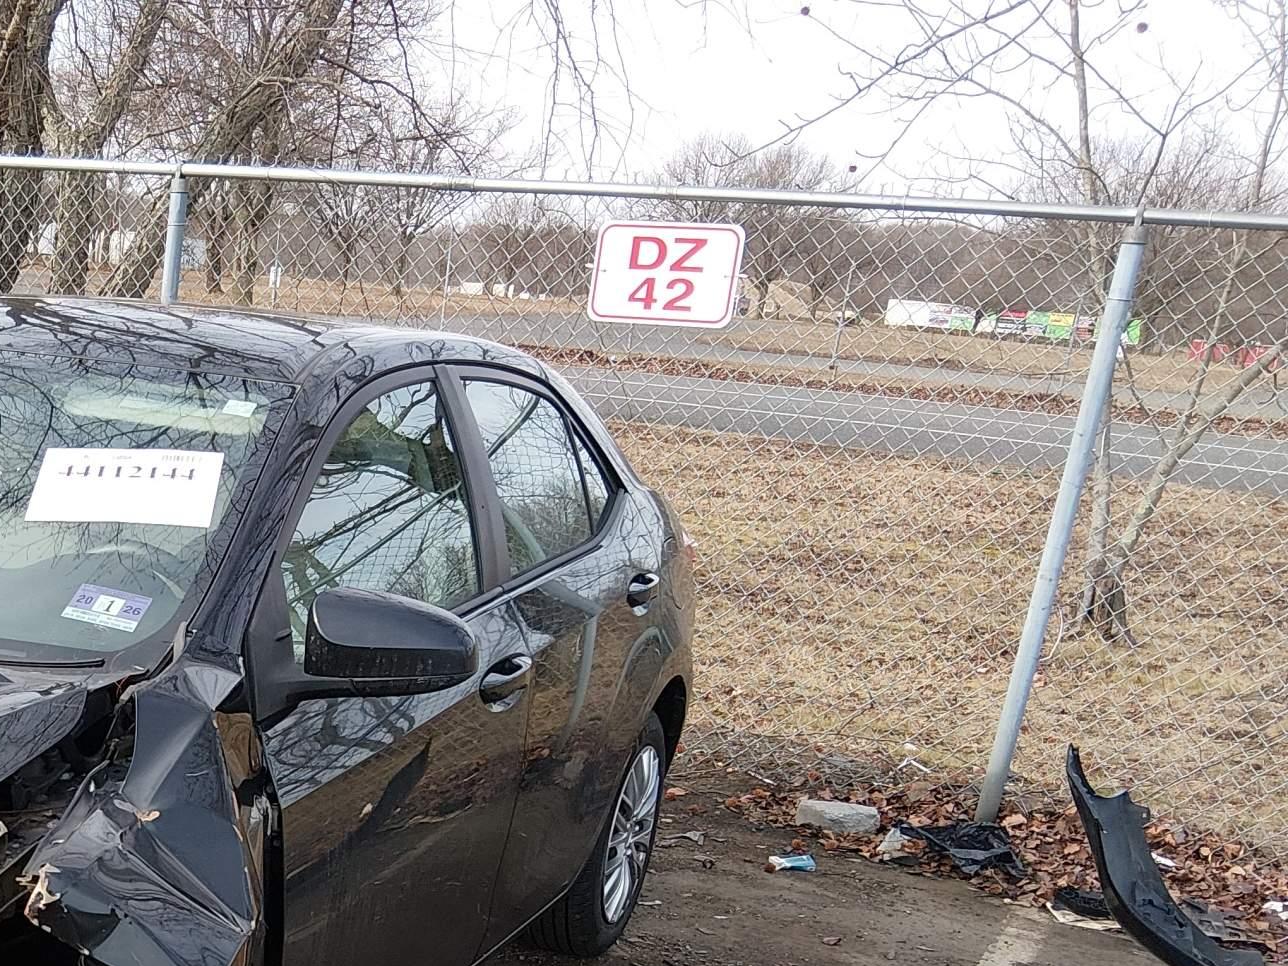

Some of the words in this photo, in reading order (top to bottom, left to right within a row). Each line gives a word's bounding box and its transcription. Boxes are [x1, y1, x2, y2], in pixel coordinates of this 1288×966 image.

[628, 236, 708, 273] DZ
[627, 277, 695, 312] 42
[58, 465, 197, 481] 44112144
[76, 594, 94, 605] 20
[103, 600, 116, 613] 1
[123, 605, 143, 616] 26
